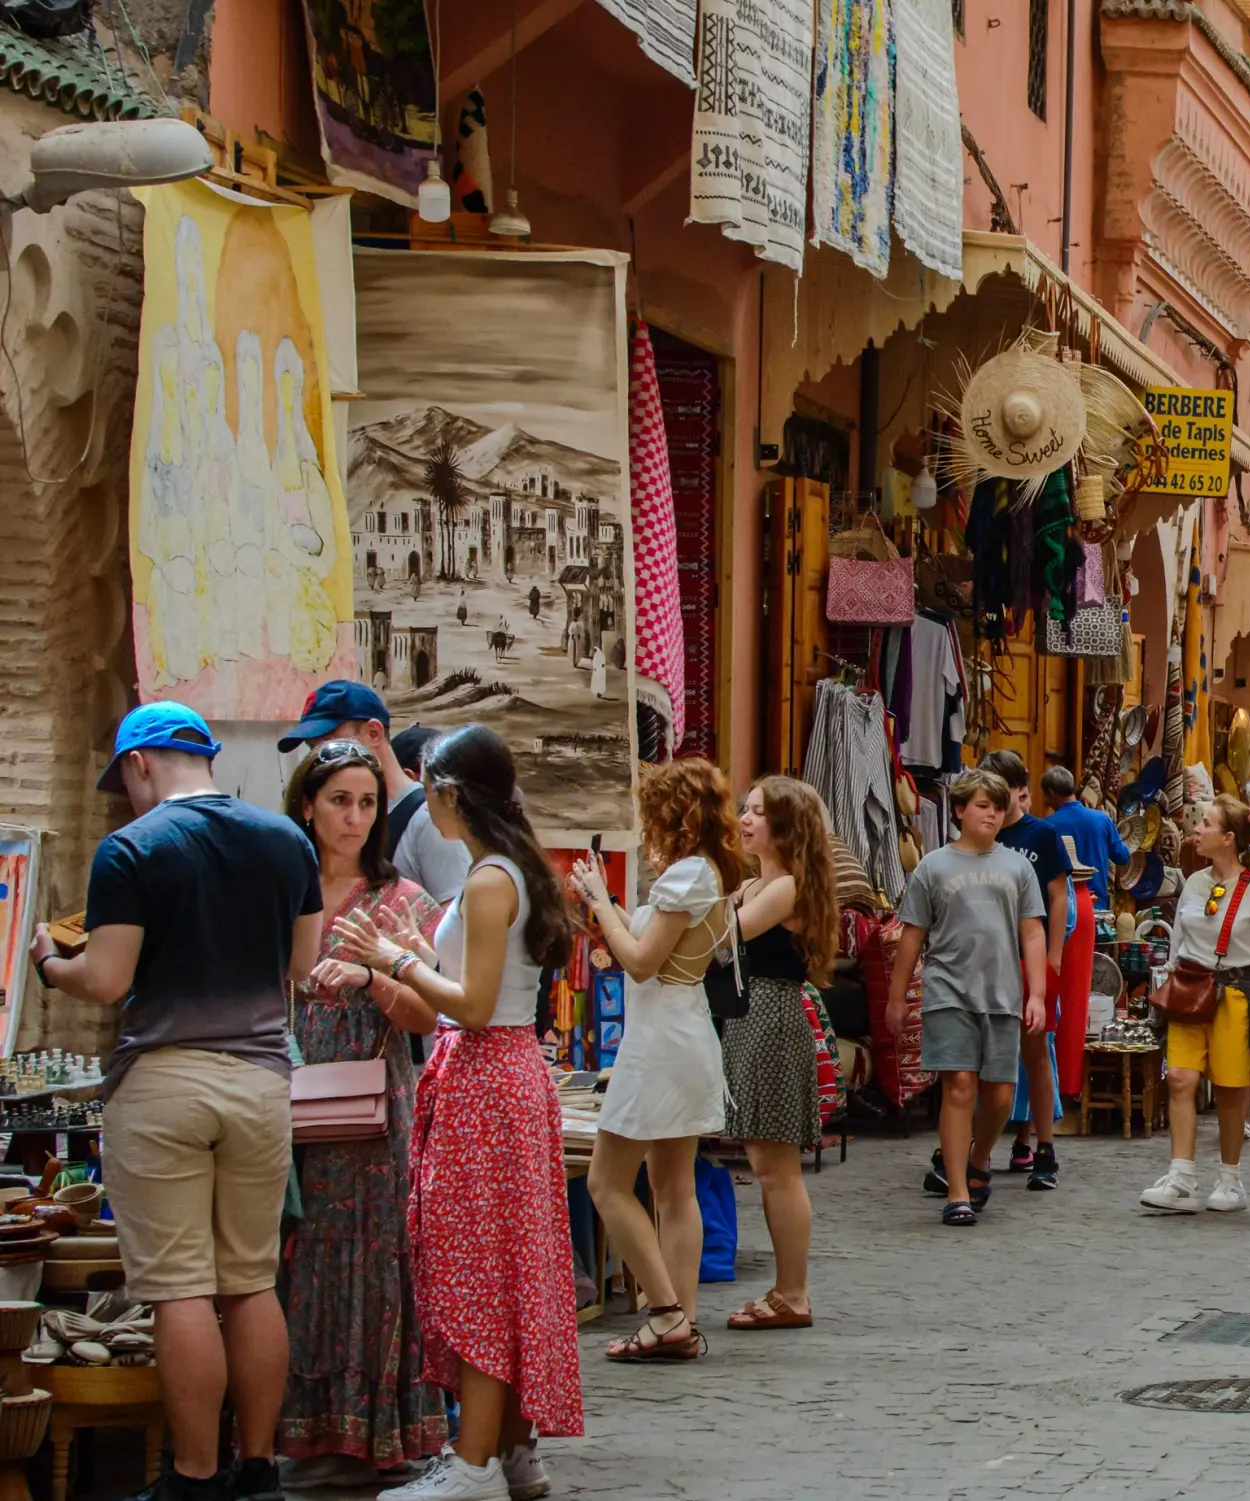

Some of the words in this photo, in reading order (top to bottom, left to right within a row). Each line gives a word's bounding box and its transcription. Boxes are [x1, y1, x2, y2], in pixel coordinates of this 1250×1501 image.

[1145, 392, 1226, 418] BERBERE
[971, 409, 1003, 460] Home
[1006, 427, 1064, 466] Sweet
[1162, 420, 1182, 439] de
[1186, 422, 1225, 447] Tapis
[1171, 473, 1185, 489] 42
[1189, 475, 1204, 491] 65
[1208, 476, 1222, 492] 20
